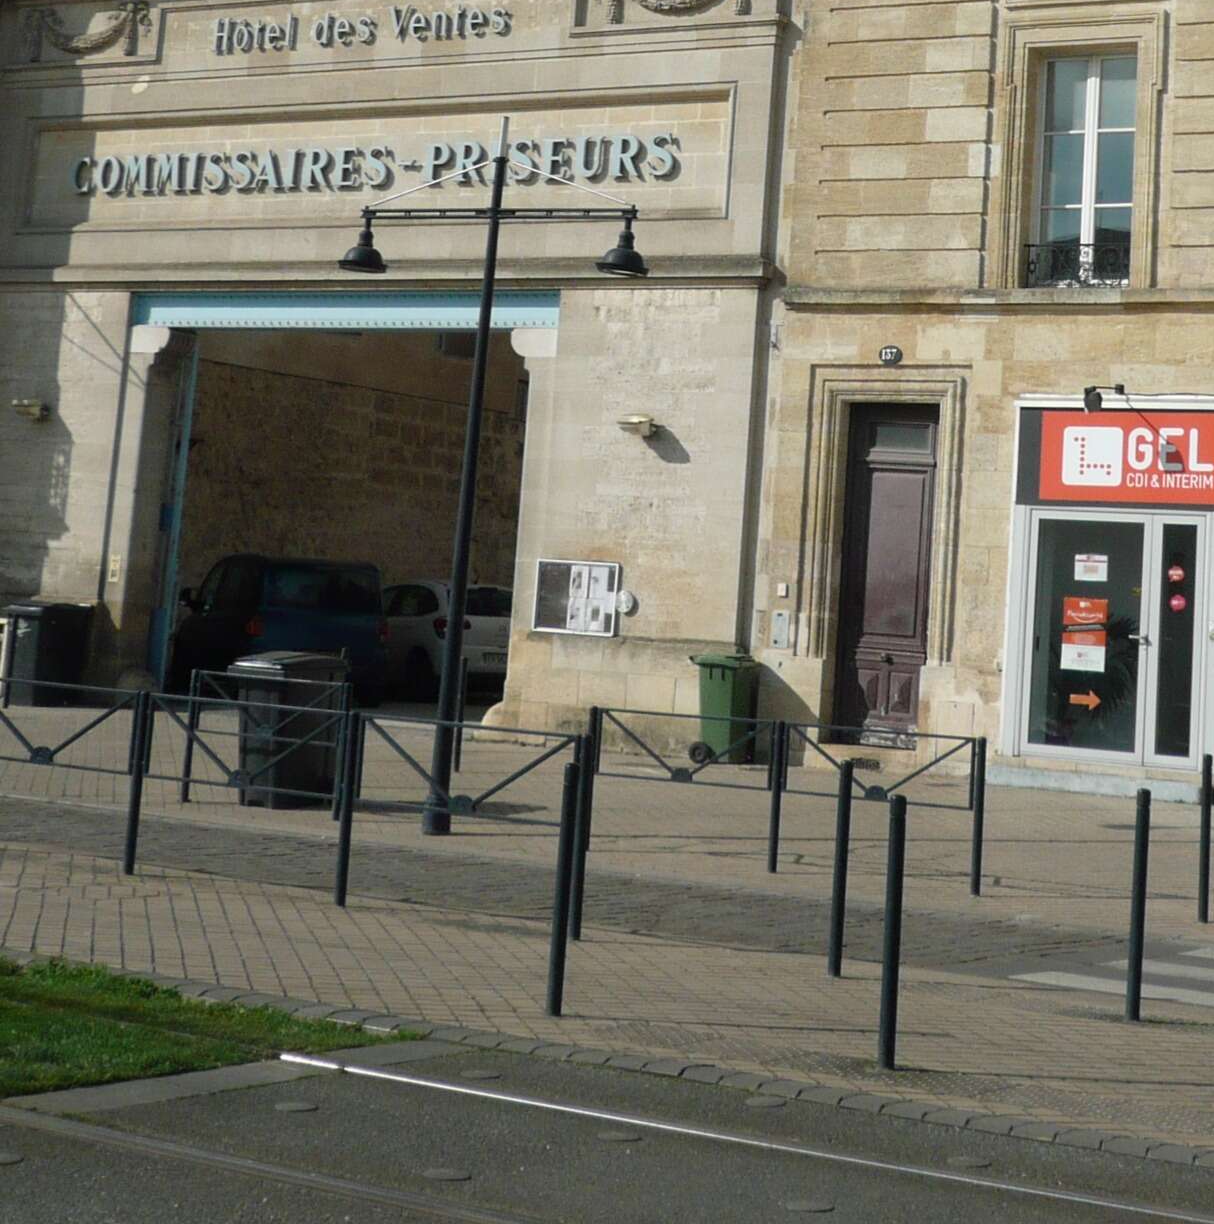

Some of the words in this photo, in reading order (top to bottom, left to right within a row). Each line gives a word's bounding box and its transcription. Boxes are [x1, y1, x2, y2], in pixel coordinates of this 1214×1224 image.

[212, 11, 298, 54] Hôtel
[312, 13, 378, 47] des
[389, 4, 513, 43] Ventes
[1127, 427, 1214, 472] GEL
[1126, 472, 1148, 488] CDI
[1150, 474, 1160, 489] &
[1162, 474, 1214, 490] INTERIM
